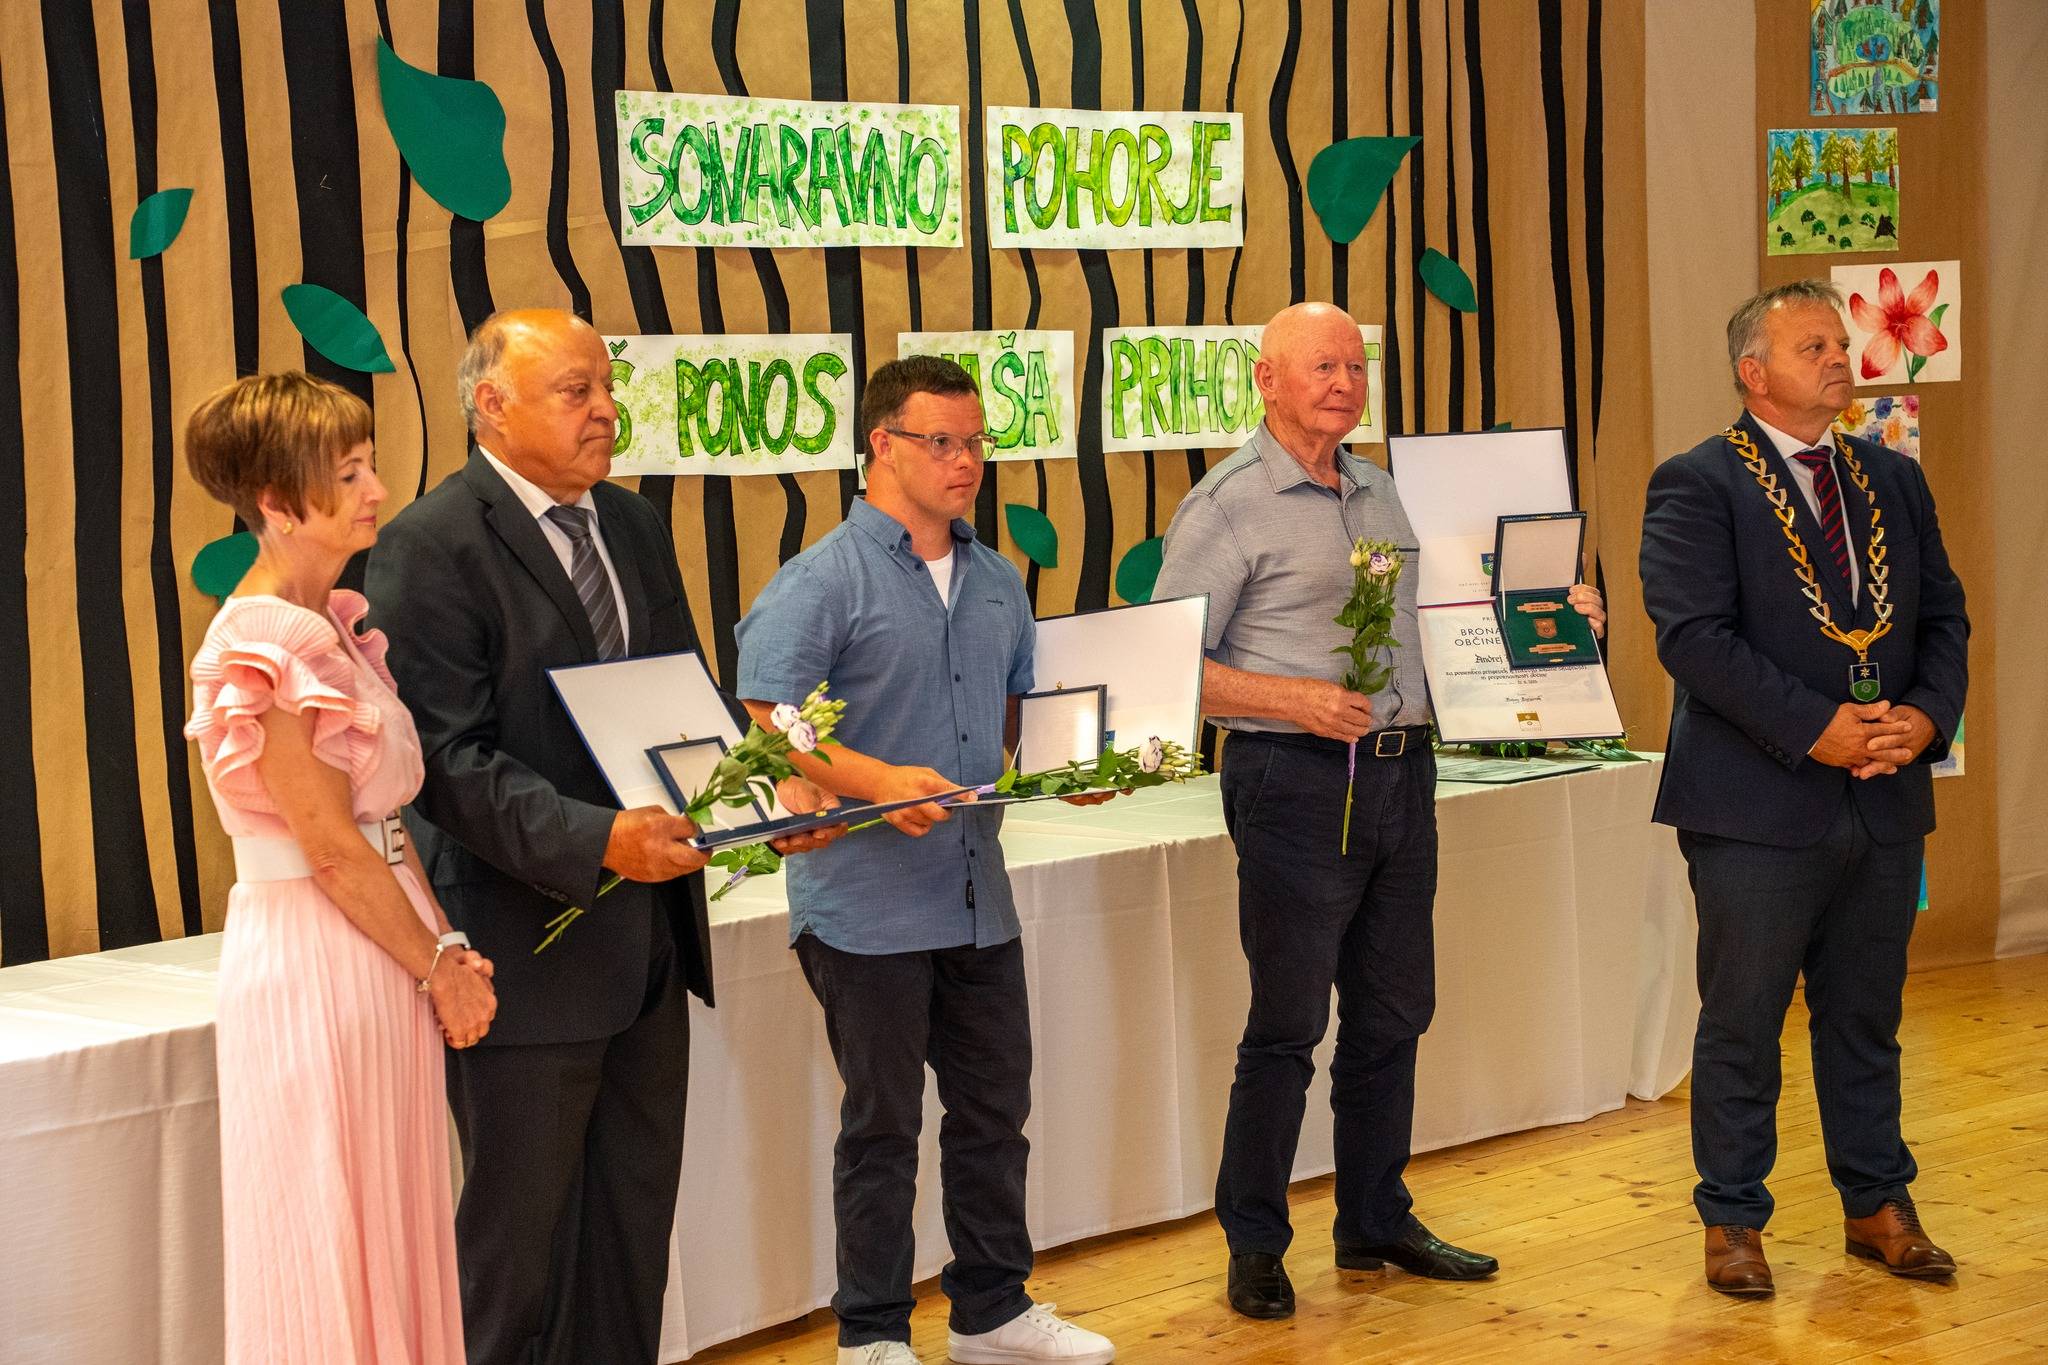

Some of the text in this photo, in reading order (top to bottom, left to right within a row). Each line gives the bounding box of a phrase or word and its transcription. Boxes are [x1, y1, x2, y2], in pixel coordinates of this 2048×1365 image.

[628, 117, 1232, 235] SONARAVNO POHORJE
[676, 352, 847, 458] PONOS
[1454, 636, 1501, 647] OBČINE
[1474, 653, 1504, 665] Andrej
